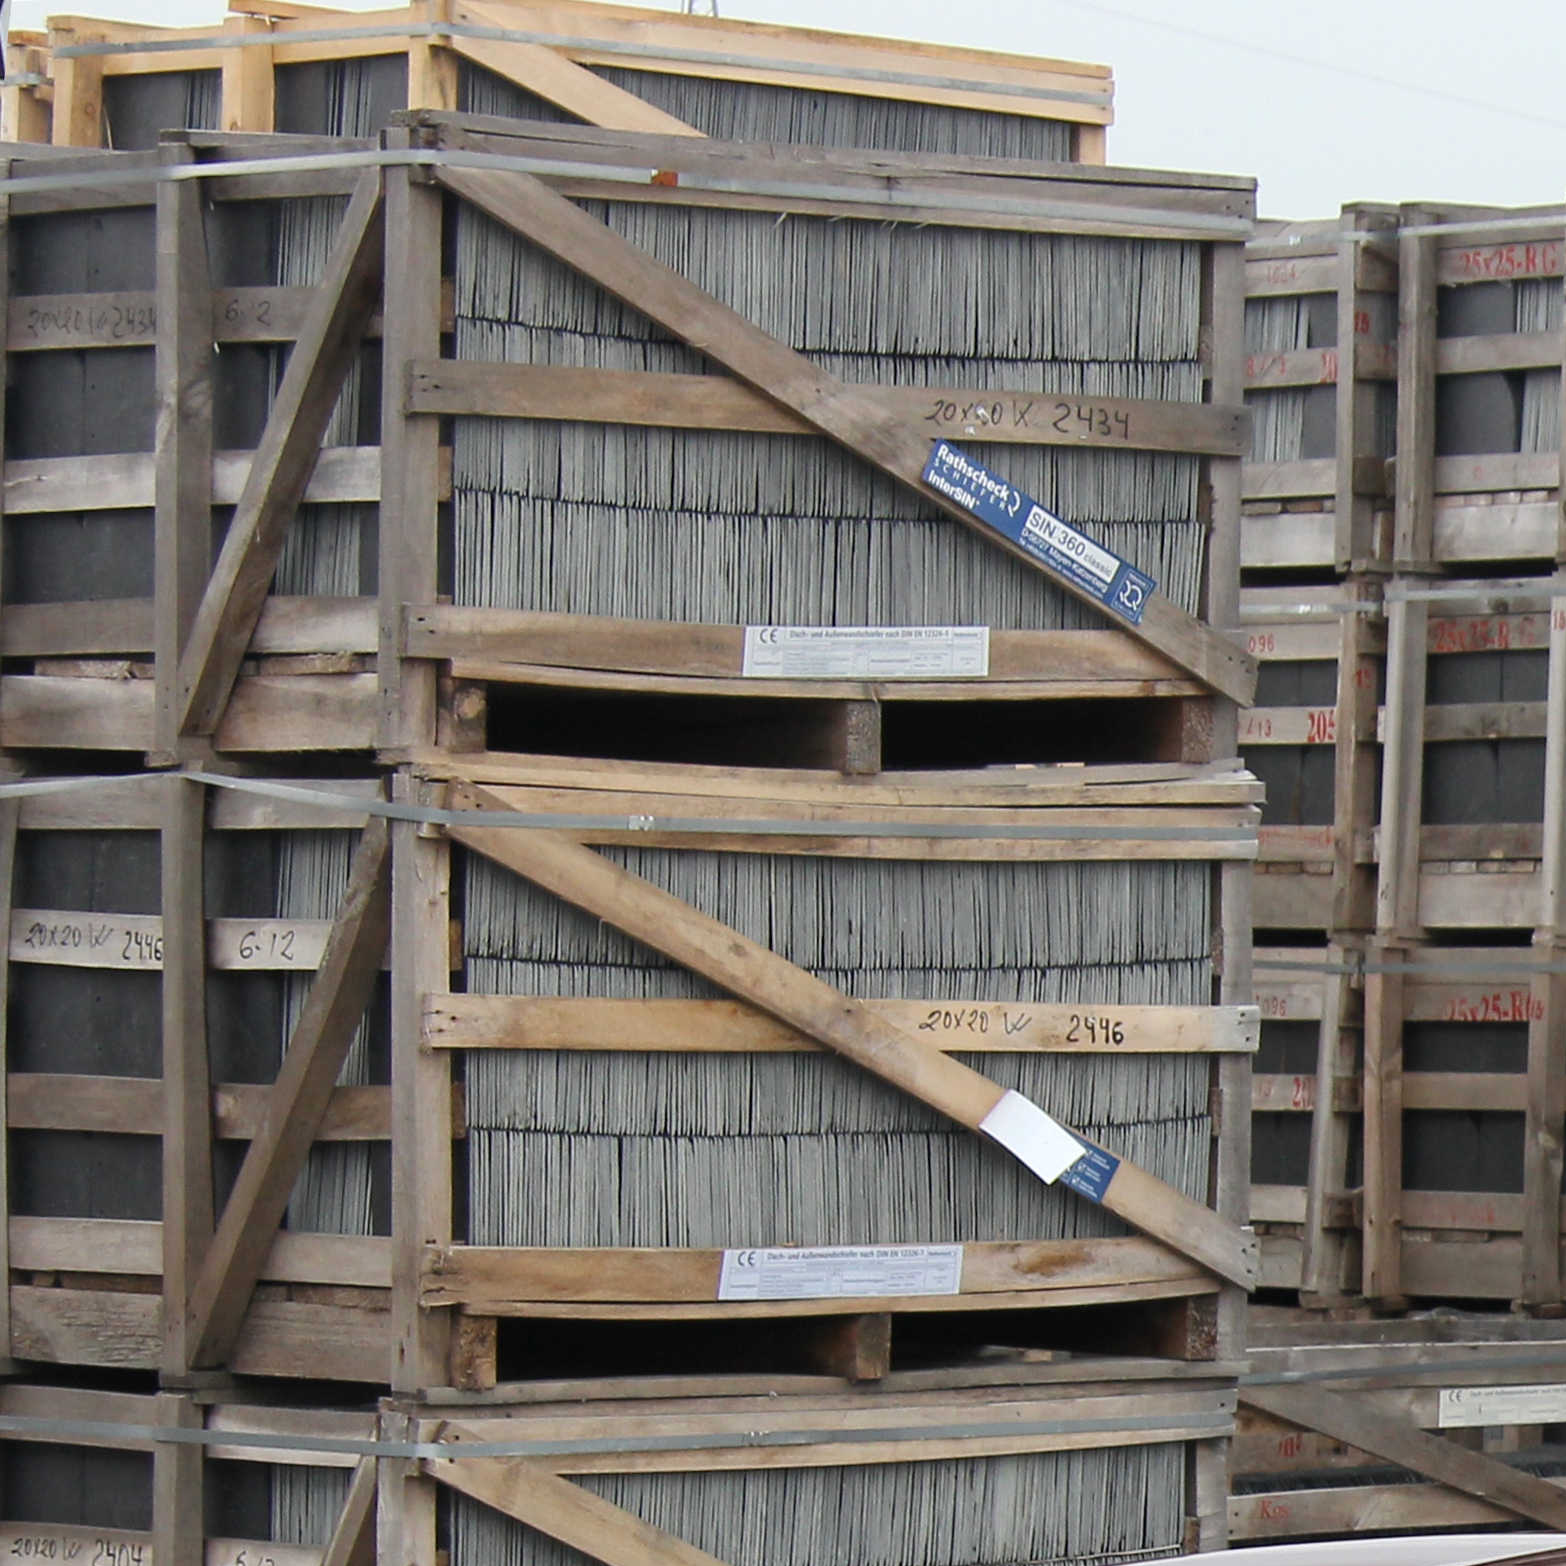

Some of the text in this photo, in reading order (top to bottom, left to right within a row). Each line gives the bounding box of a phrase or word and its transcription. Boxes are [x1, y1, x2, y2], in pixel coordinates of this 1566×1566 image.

[936, 444, 1010, 502] Rathscheck
[1029, 511, 1057, 540] SIN
[1057, 529, 1086, 558] 360
